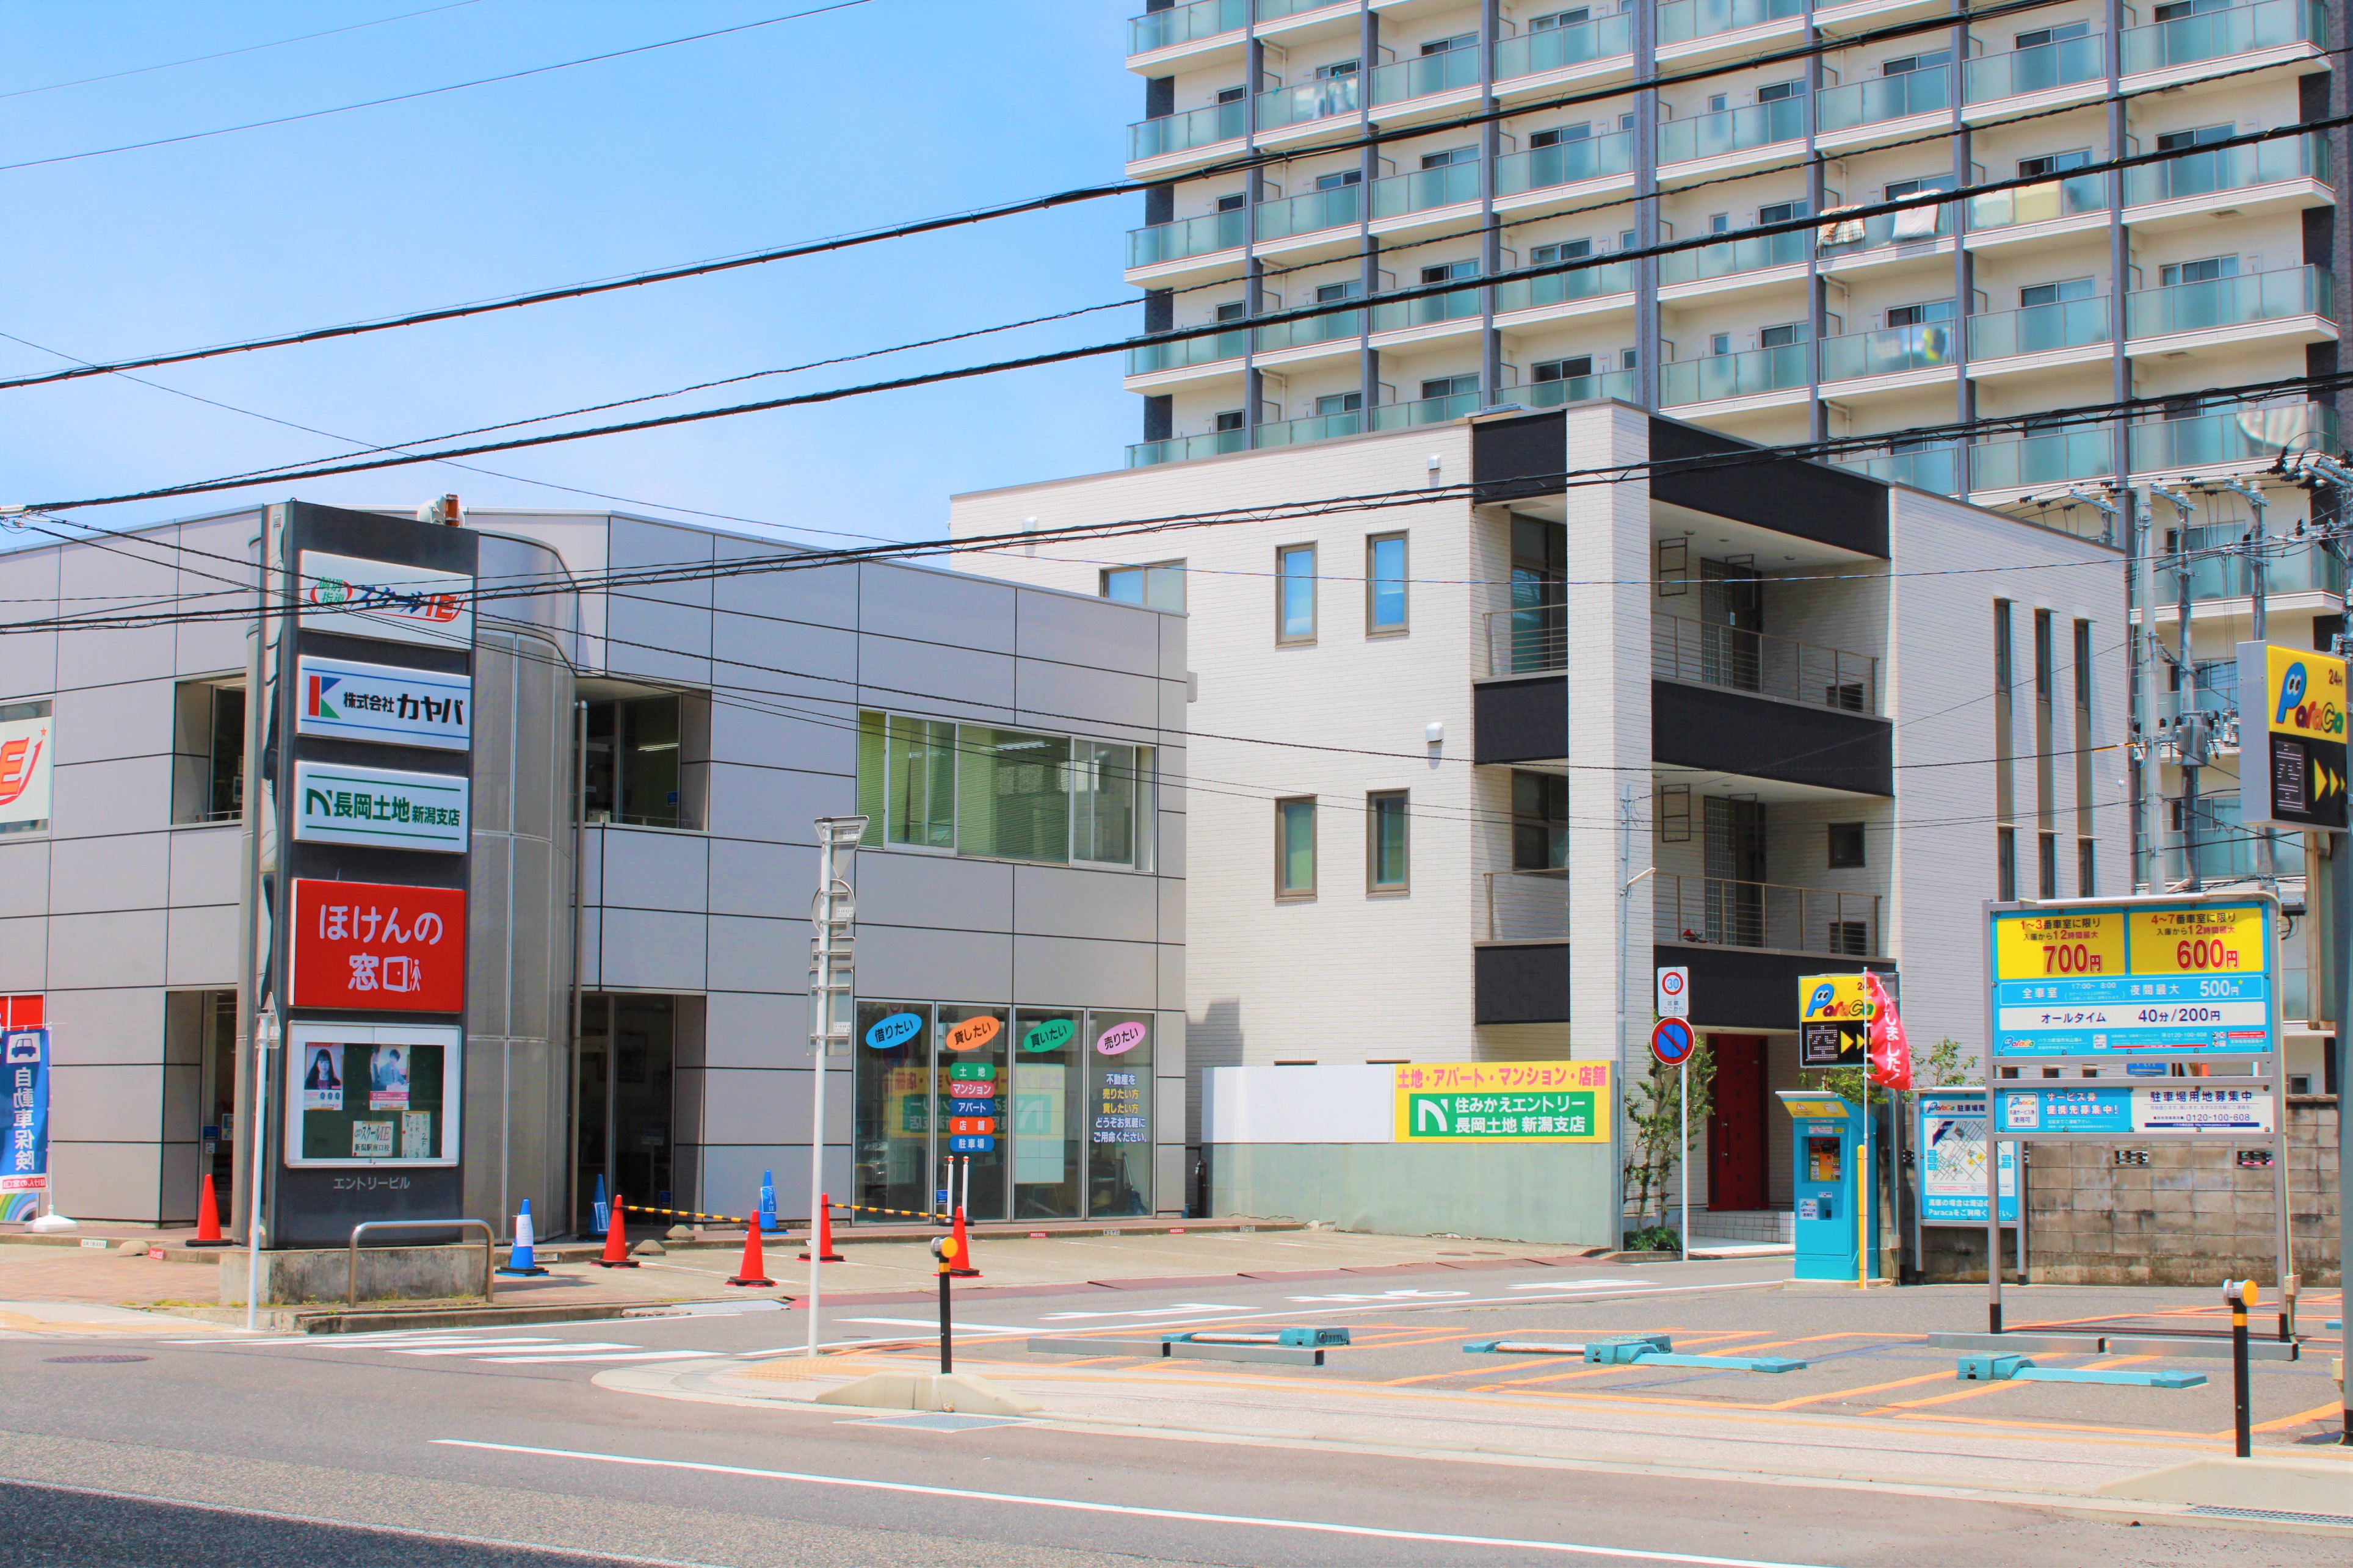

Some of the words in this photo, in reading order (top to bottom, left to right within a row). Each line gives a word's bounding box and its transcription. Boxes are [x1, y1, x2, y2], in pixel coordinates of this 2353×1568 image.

[2329, 669, 2343, 687] 24H
[319, 904, 444, 945] ほけんの
[2042, 944, 2102, 974] 700円
[2177, 939, 2239, 969] 600円
[348, 952, 411, 992] 窓口
[1667, 978, 1680, 989] 30
[2130, 984, 2180, 996] 夜間最大
[2200, 980, 2239, 997] 500円
[2022, 987, 2058, 999] 全車室
[2041, 1012, 2106, 1024] オールタイム
[2138, 1008, 2221, 1022] 40分/200円
[874, 1019, 914, 1044] 借りたい
[954, 1022, 992, 1046] 貸したい
[1030, 1025, 1067, 1048] 買いたい
[1104, 1028, 1139, 1050] 売りたい
[959, 1066, 985, 1077] 土地
[1106, 1073, 1136, 1085] 不動産を
[952, 1083, 991, 1094] マンション
[1103, 1088, 1139, 1099] 売りたい方
[2046, 1092, 2097, 1102] サービス券
[2149, 1090, 2252, 1102] 駐車場用地募集中
[957, 1102, 987, 1113] アパート
[1103, 1102, 1139, 1114] 貸したい方
[1455, 1095, 1586, 1114] 住みかえエントリー
[1095, 1117, 1146, 1129] どうぞお気軽に
[1455, 1116, 1517, 1133] 長岡土地
[958, 1138, 985, 1149] 駐車場
[1093, 1131, 1147, 1143] ご用命ください。
[333, 1176, 410, 1190] エントリービル
